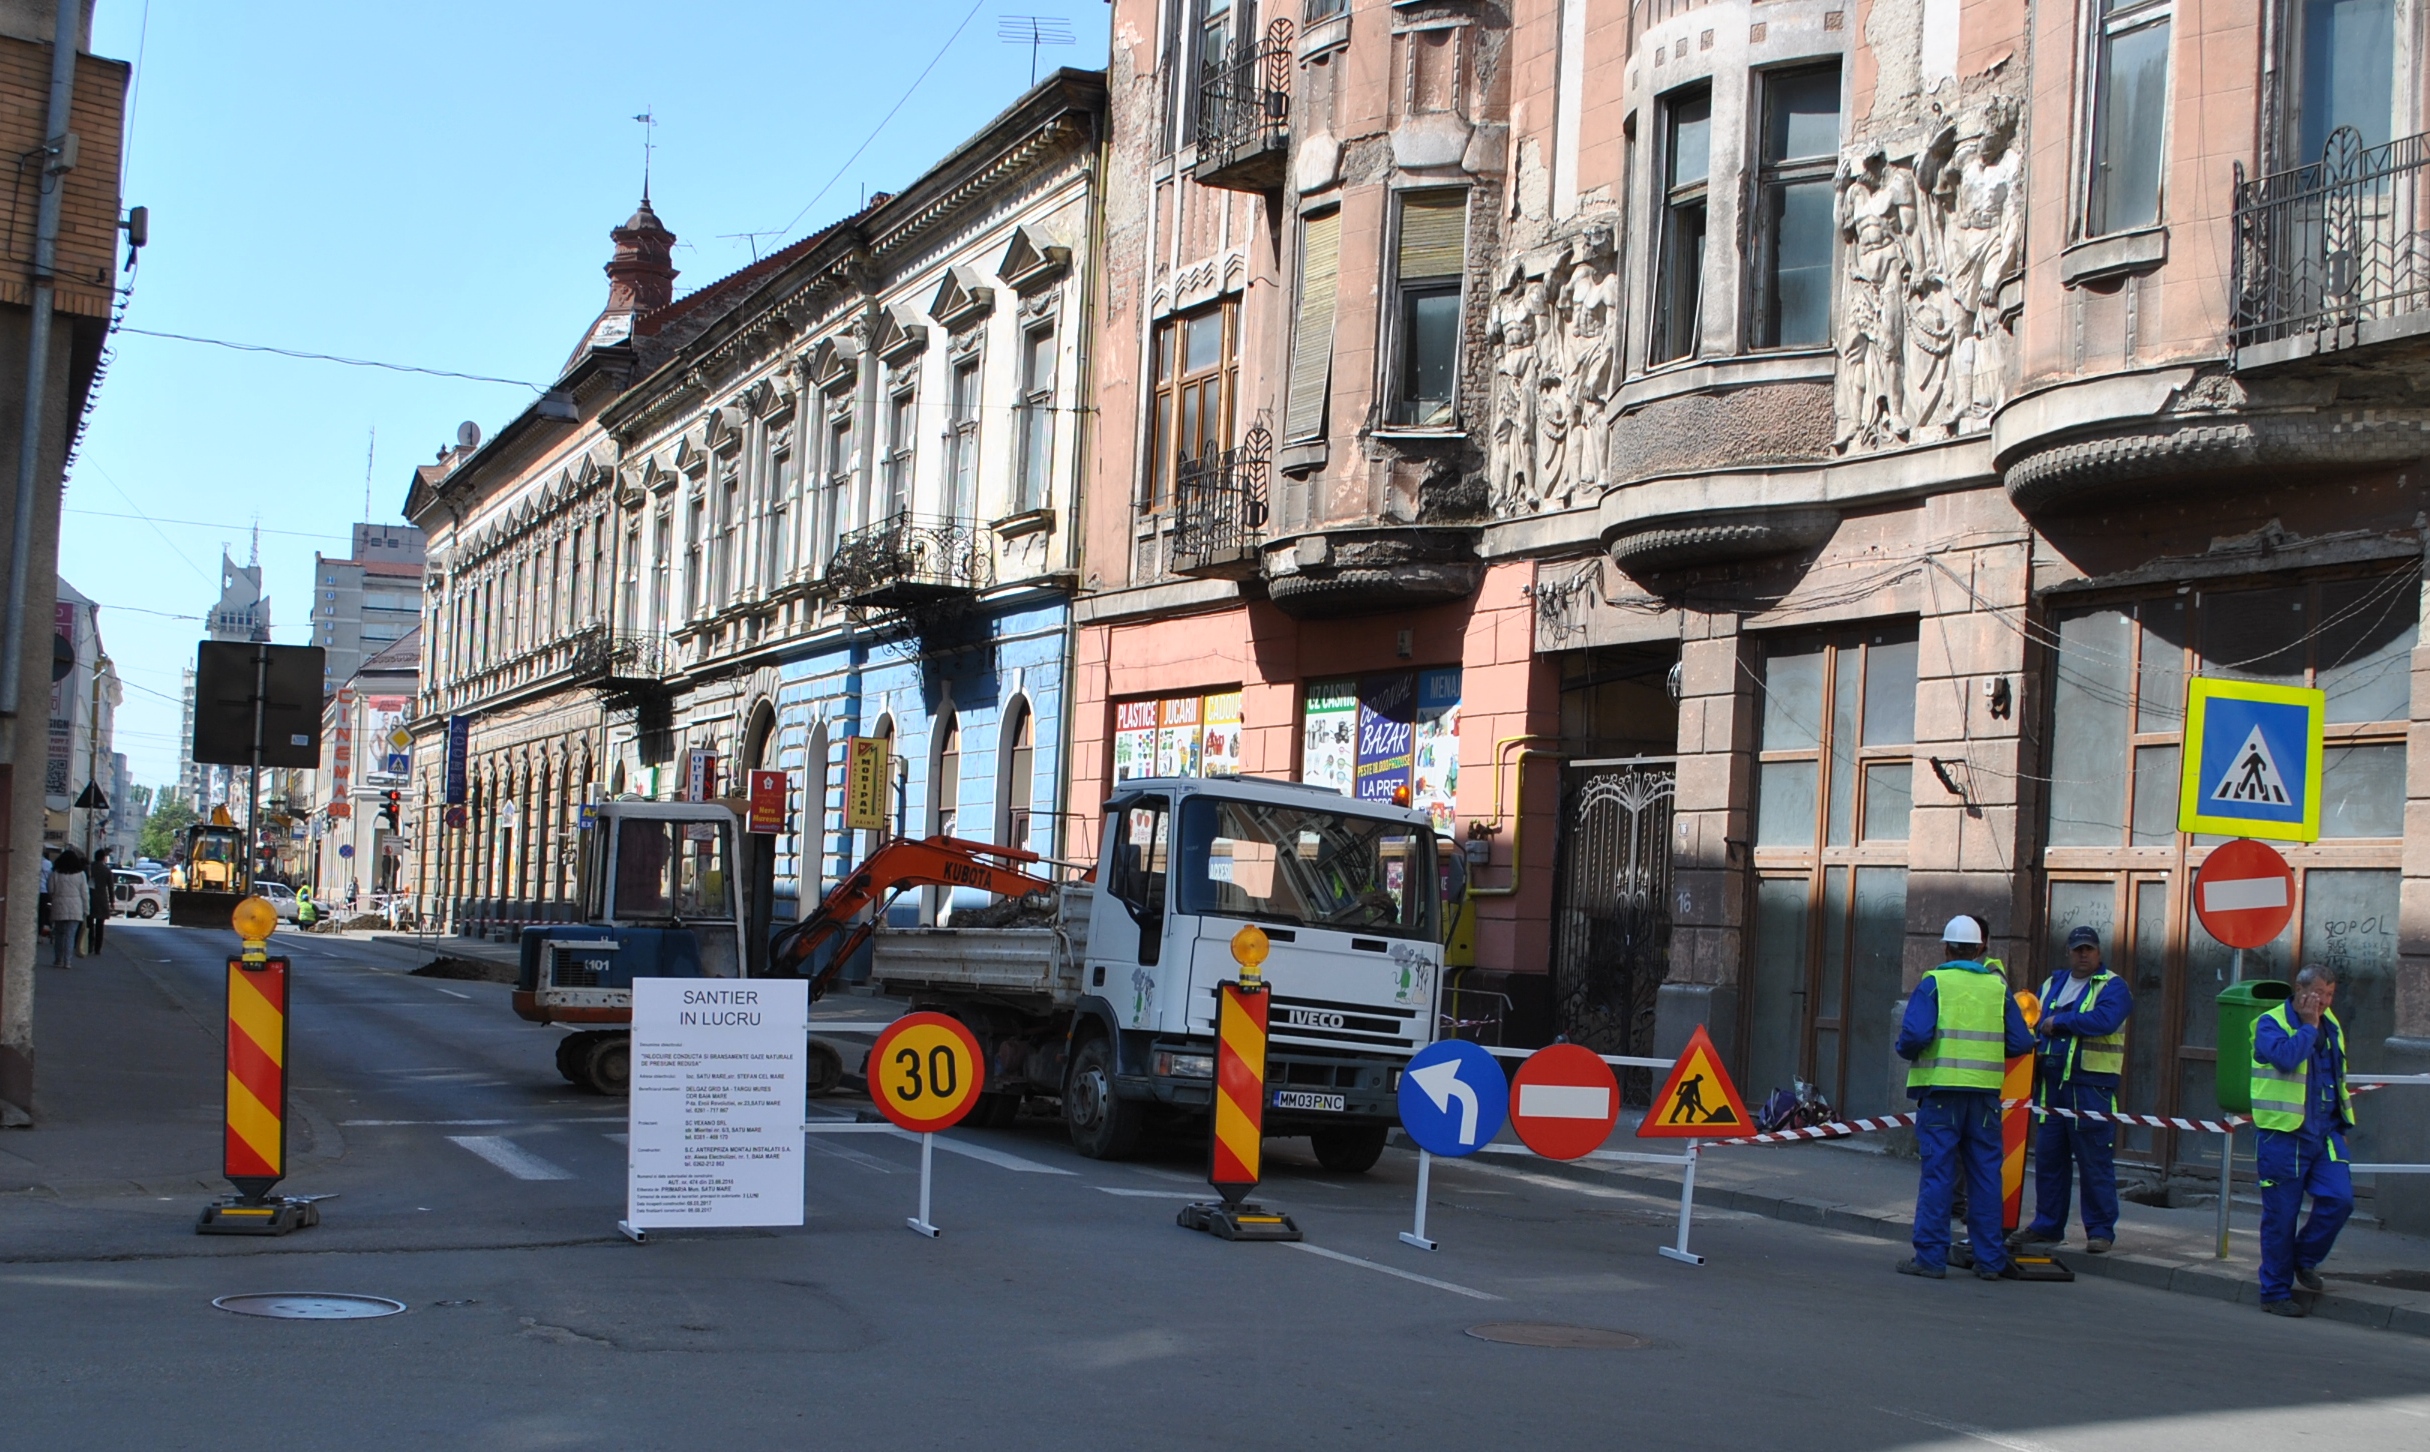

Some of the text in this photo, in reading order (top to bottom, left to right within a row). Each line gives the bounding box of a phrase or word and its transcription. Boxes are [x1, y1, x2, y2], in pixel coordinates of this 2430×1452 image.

[1308, 682, 1357, 710] UZ CASNIC
[1360, 673, 1414, 728] COLONIAL
[1117, 701, 1156, 729] PLASTICE
[1164, 698, 1198, 725] JUCARII
[333, 689, 353, 798] CINEMA
[1360, 722, 1411, 756] BAZAR
[859, 758, 871, 816] MOBIPAN
[1362, 780, 1376, 797] LA
[943, 860, 992, 889] KUBOTA
[1676, 892, 1692, 914] 16
[683, 990, 758, 1005] SANTIER
[680, 1011, 761, 1026] IN LUCRU
[1288, 1010, 1344, 1029] IVECO
[895, 1044, 957, 1101] 30
[1279, 1092, 1342, 1110] MM03PNC
